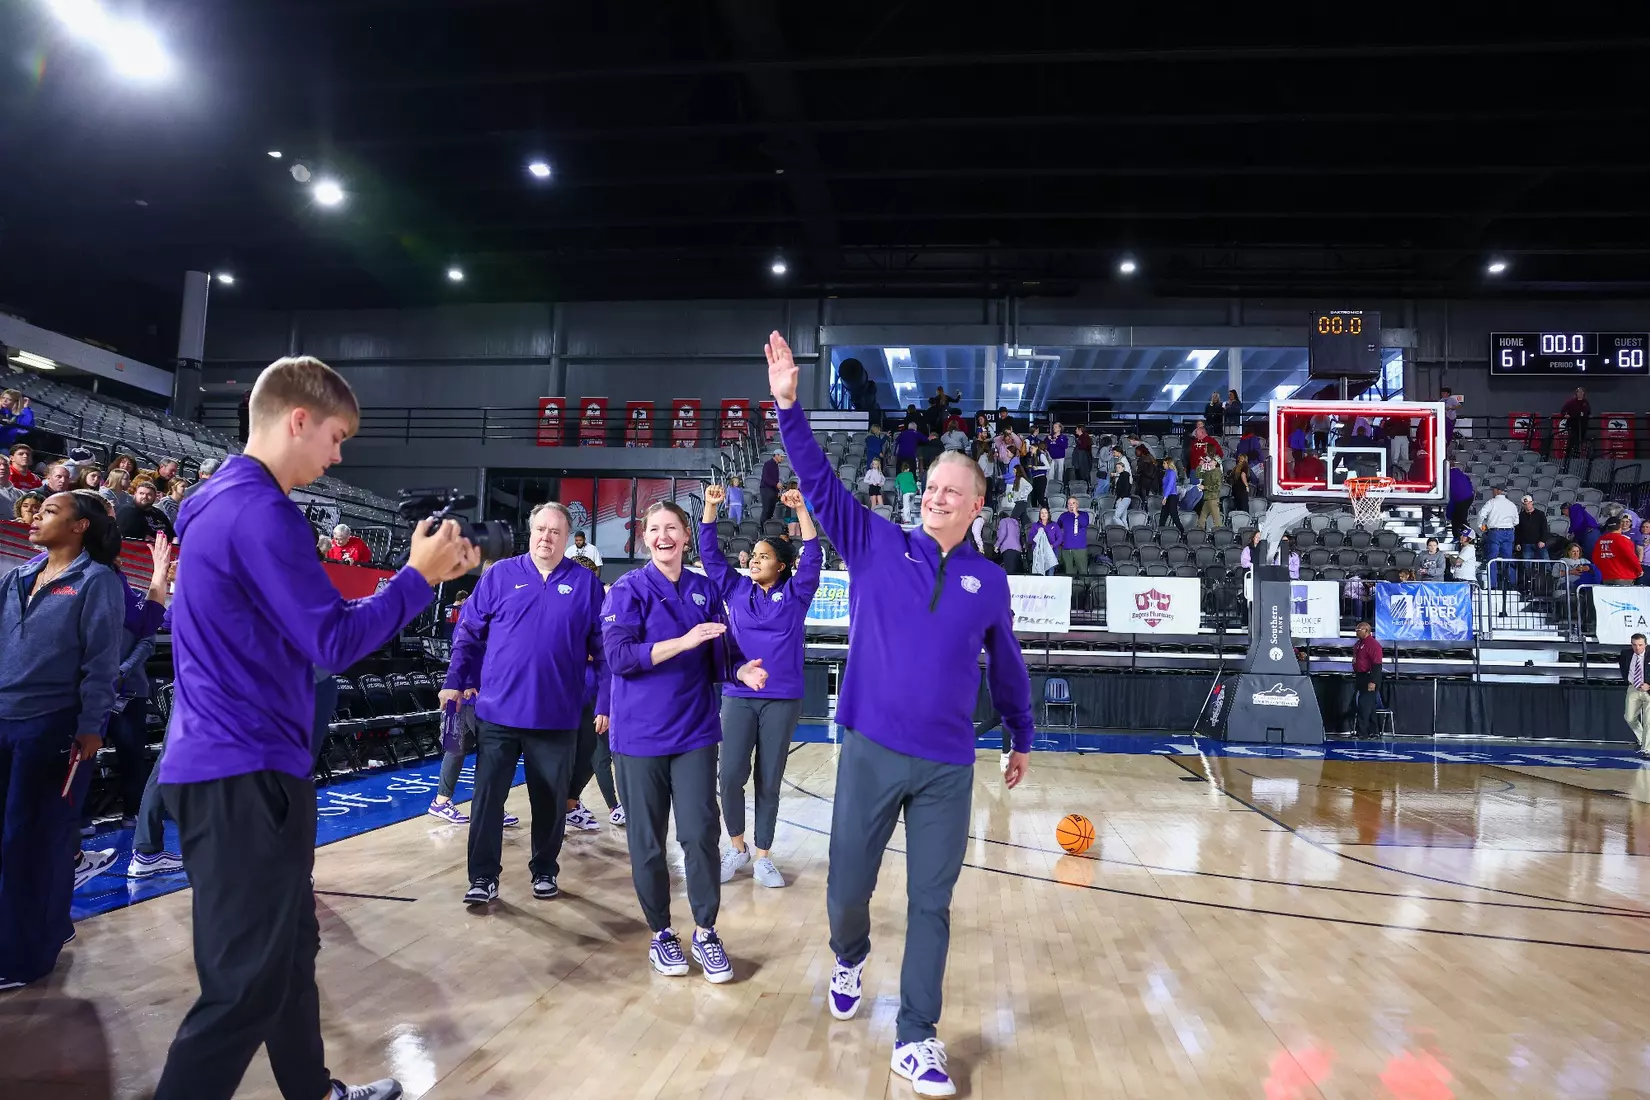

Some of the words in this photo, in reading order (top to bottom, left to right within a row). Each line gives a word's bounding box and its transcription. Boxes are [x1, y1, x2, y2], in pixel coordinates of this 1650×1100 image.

[1318, 316, 1361, 335] 00.0
[1499, 338, 1524, 347] HOME
[1542, 334, 1584, 353] 00.0
[1614, 338, 1643, 347] GUEST
[1501, 349, 1526, 367] 61
[1618, 349, 1643, 367] 60
[1576, 359, 1586, 371] 4
[1415, 595, 1457, 606] UNITED
[1416, 606, 1456, 618] FIBER
[1270, 605, 1278, 645] Southern
